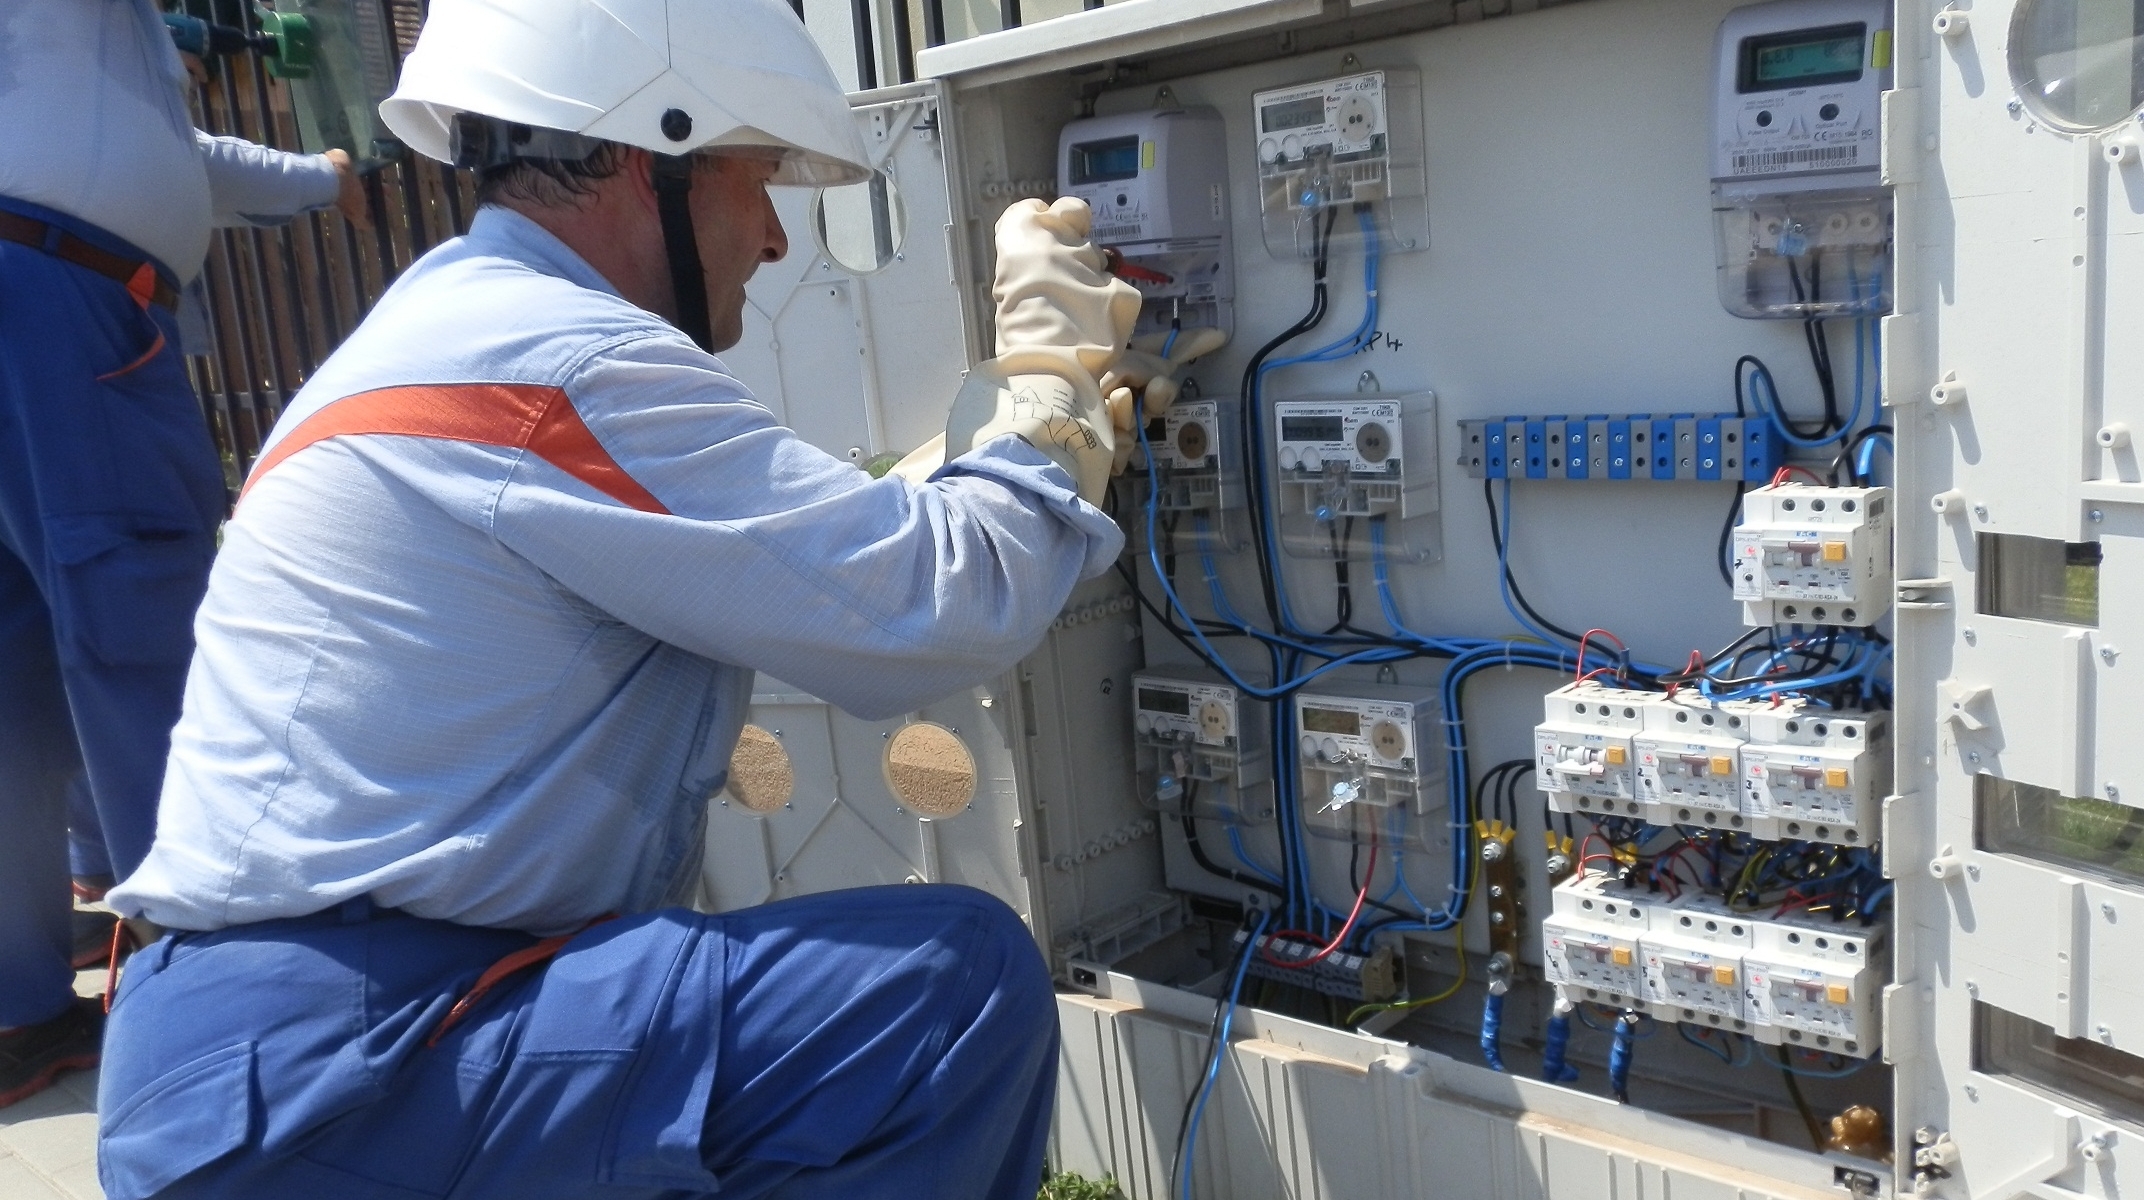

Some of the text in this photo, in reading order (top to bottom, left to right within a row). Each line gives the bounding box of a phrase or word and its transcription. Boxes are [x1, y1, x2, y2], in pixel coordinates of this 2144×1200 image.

[1637, 767, 1644, 777] 2
[1746, 779, 1753, 790] 3
[1745, 989, 1754, 1000] 6
